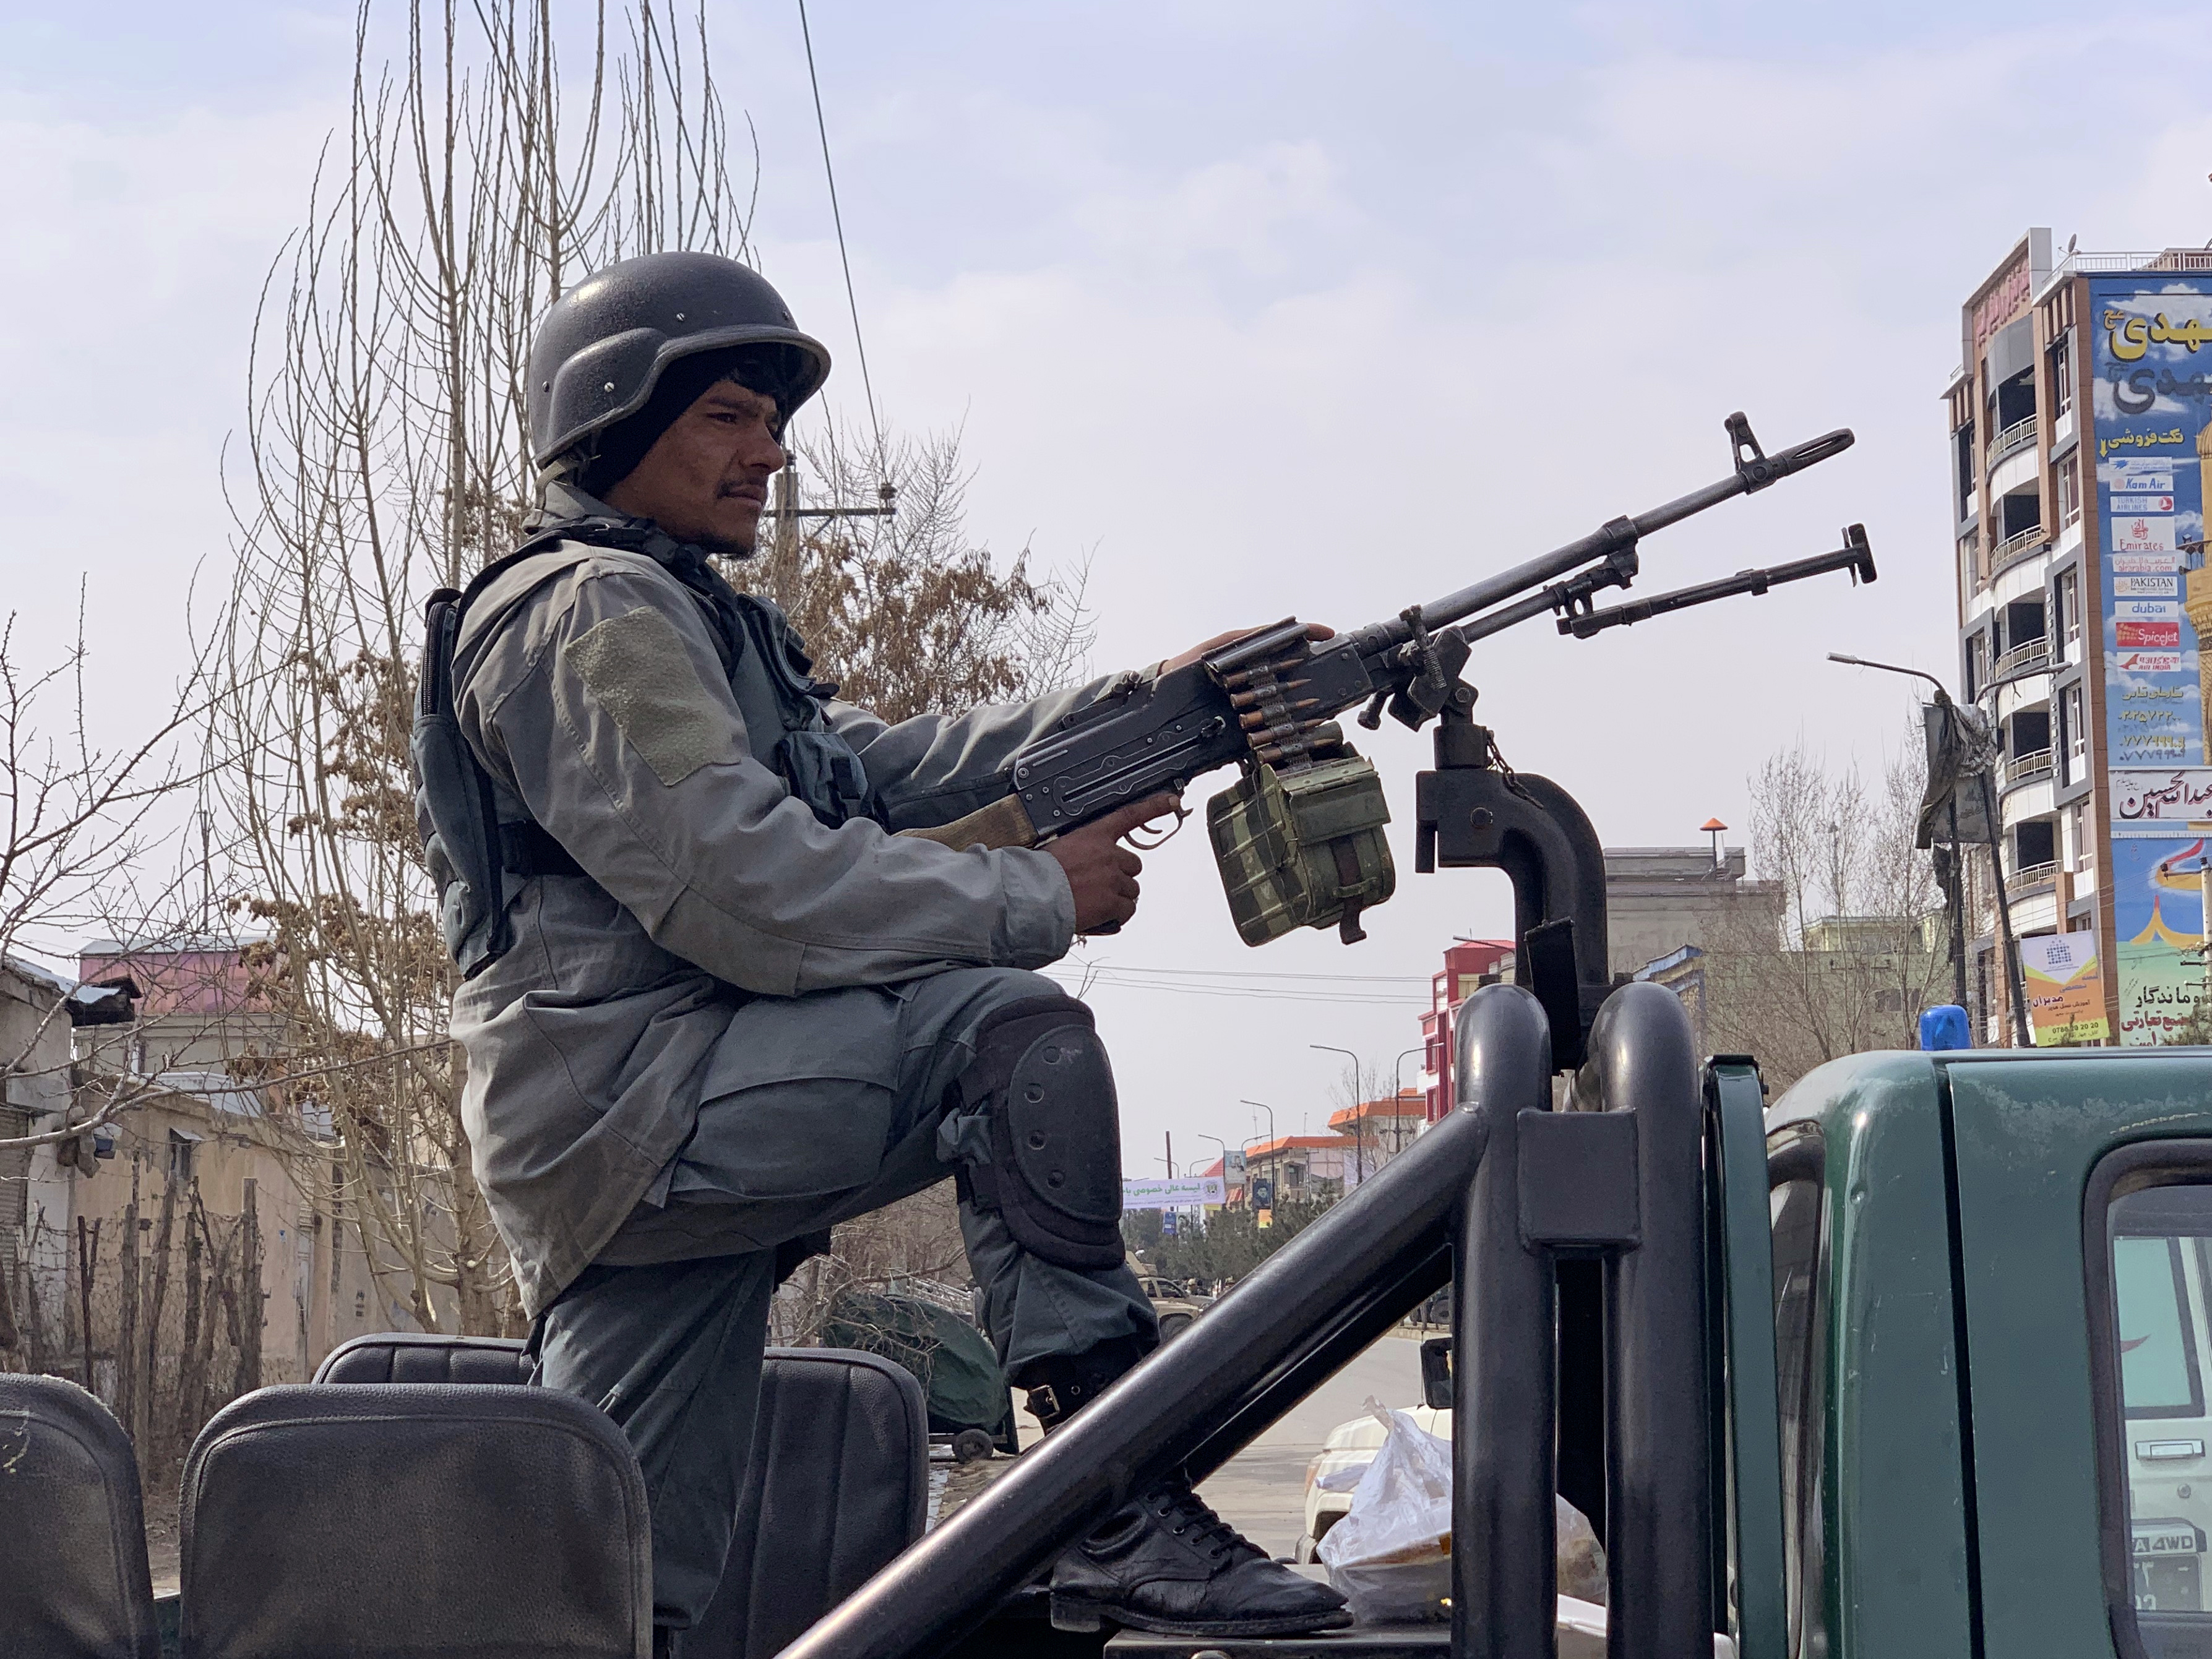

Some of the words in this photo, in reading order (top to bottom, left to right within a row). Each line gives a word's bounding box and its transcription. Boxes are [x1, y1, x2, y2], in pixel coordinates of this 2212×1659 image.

[2126, 478, 2146, 489] Kam
[2149, 478, 2166, 489] Air
[2120, 539, 2164, 551] Emirates
[2130, 577, 2173, 587] PAKISTAN
[2138, 628, 2178, 645] SpiceJet
[2151, 1535, 2193, 1551] 4WD
